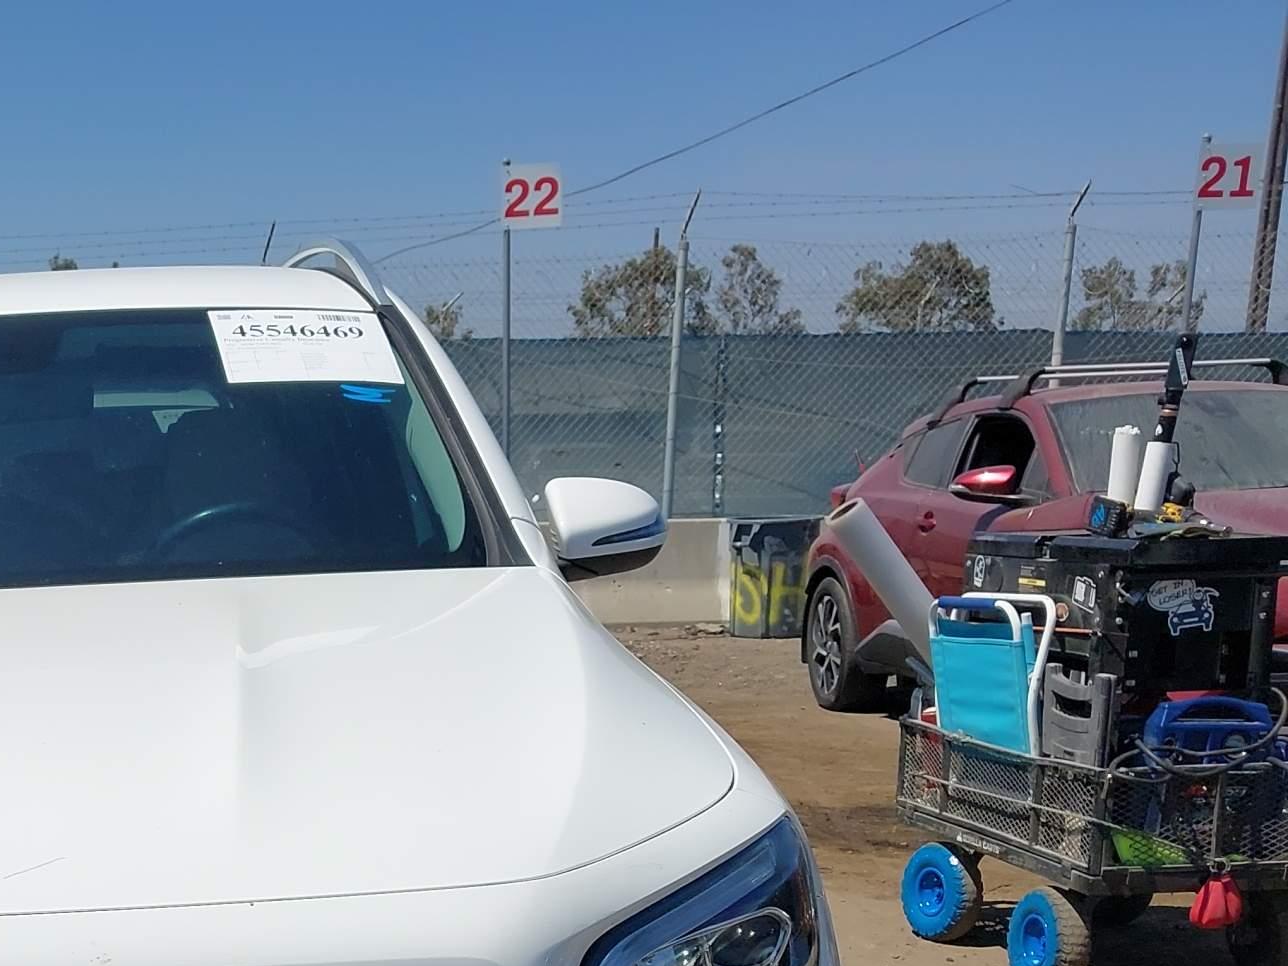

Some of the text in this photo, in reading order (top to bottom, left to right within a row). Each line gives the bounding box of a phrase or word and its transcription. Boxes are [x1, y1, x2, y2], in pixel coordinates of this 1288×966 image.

[504, 176, 560, 218] 22
[1197, 158, 1254, 199] 21
[232, 323, 364, 339] 45546469
